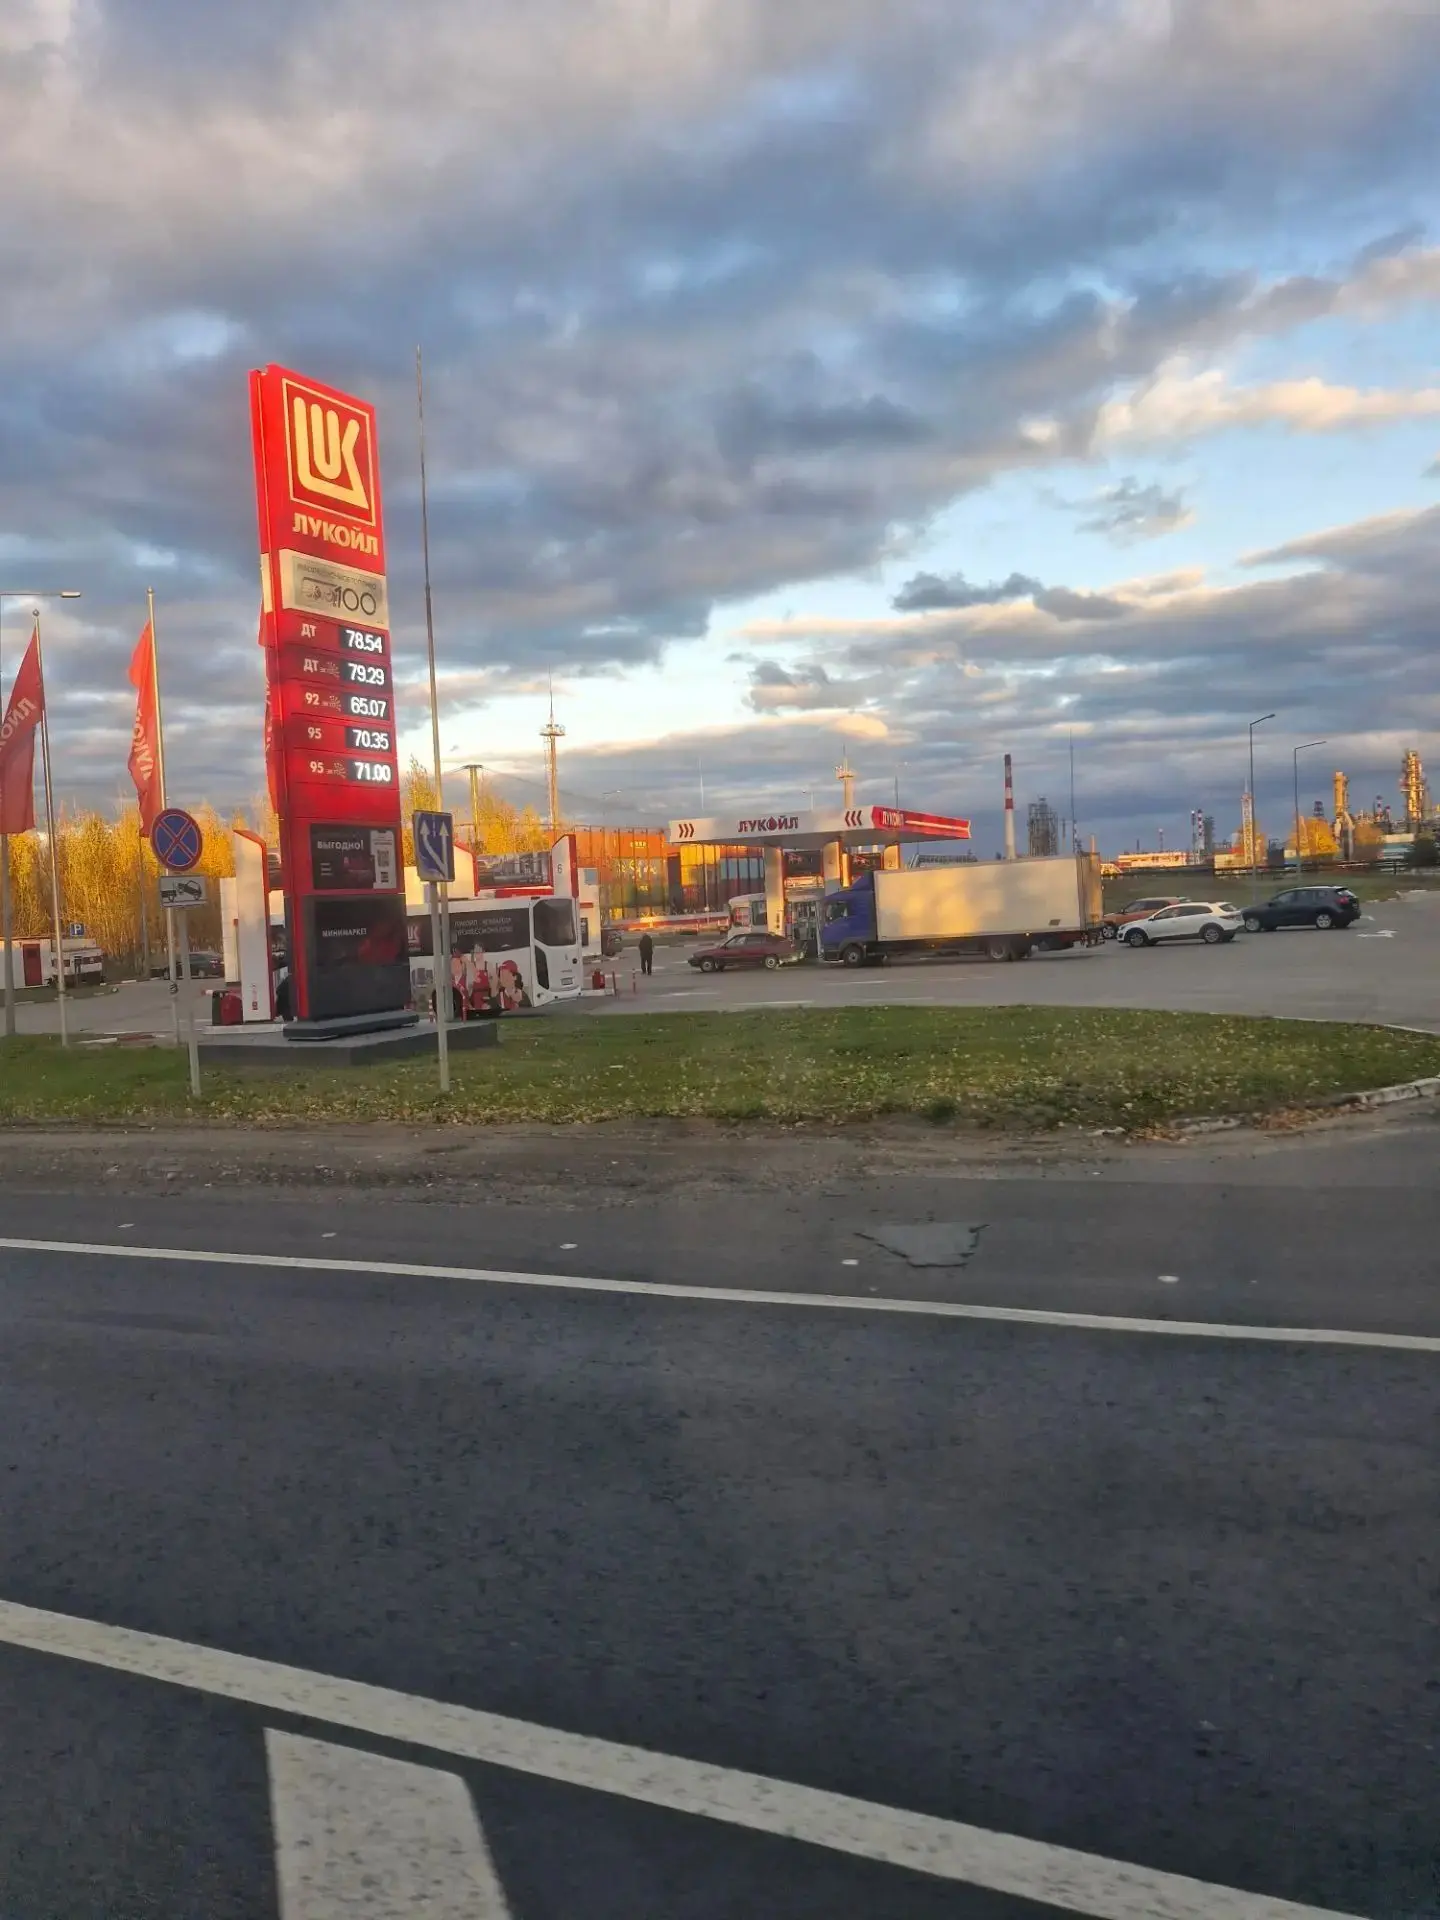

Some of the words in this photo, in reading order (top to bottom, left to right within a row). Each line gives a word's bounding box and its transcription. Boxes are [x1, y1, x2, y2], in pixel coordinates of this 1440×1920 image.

[292, 512, 379, 556] ЛУКОЙЛ
[334, 586, 377, 616] 100
[301, 623, 317, 639] ДТ
[346, 629, 383, 654] 78.54
[303, 658, 319, 674] ДТ
[348, 662, 385, 686] 79.29
[305, 692, 320, 706] 92
[350, 696, 387, 718] 65.07
[307, 727, 323, 740] 95
[352, 729, 389, 750] 70.35
[309, 761, 325, 774] 95
[354, 762, 391, 783] 71.00
[737, 814, 799, 833] ЛУКОЙЛ
[73, 924, 82, 935] P
